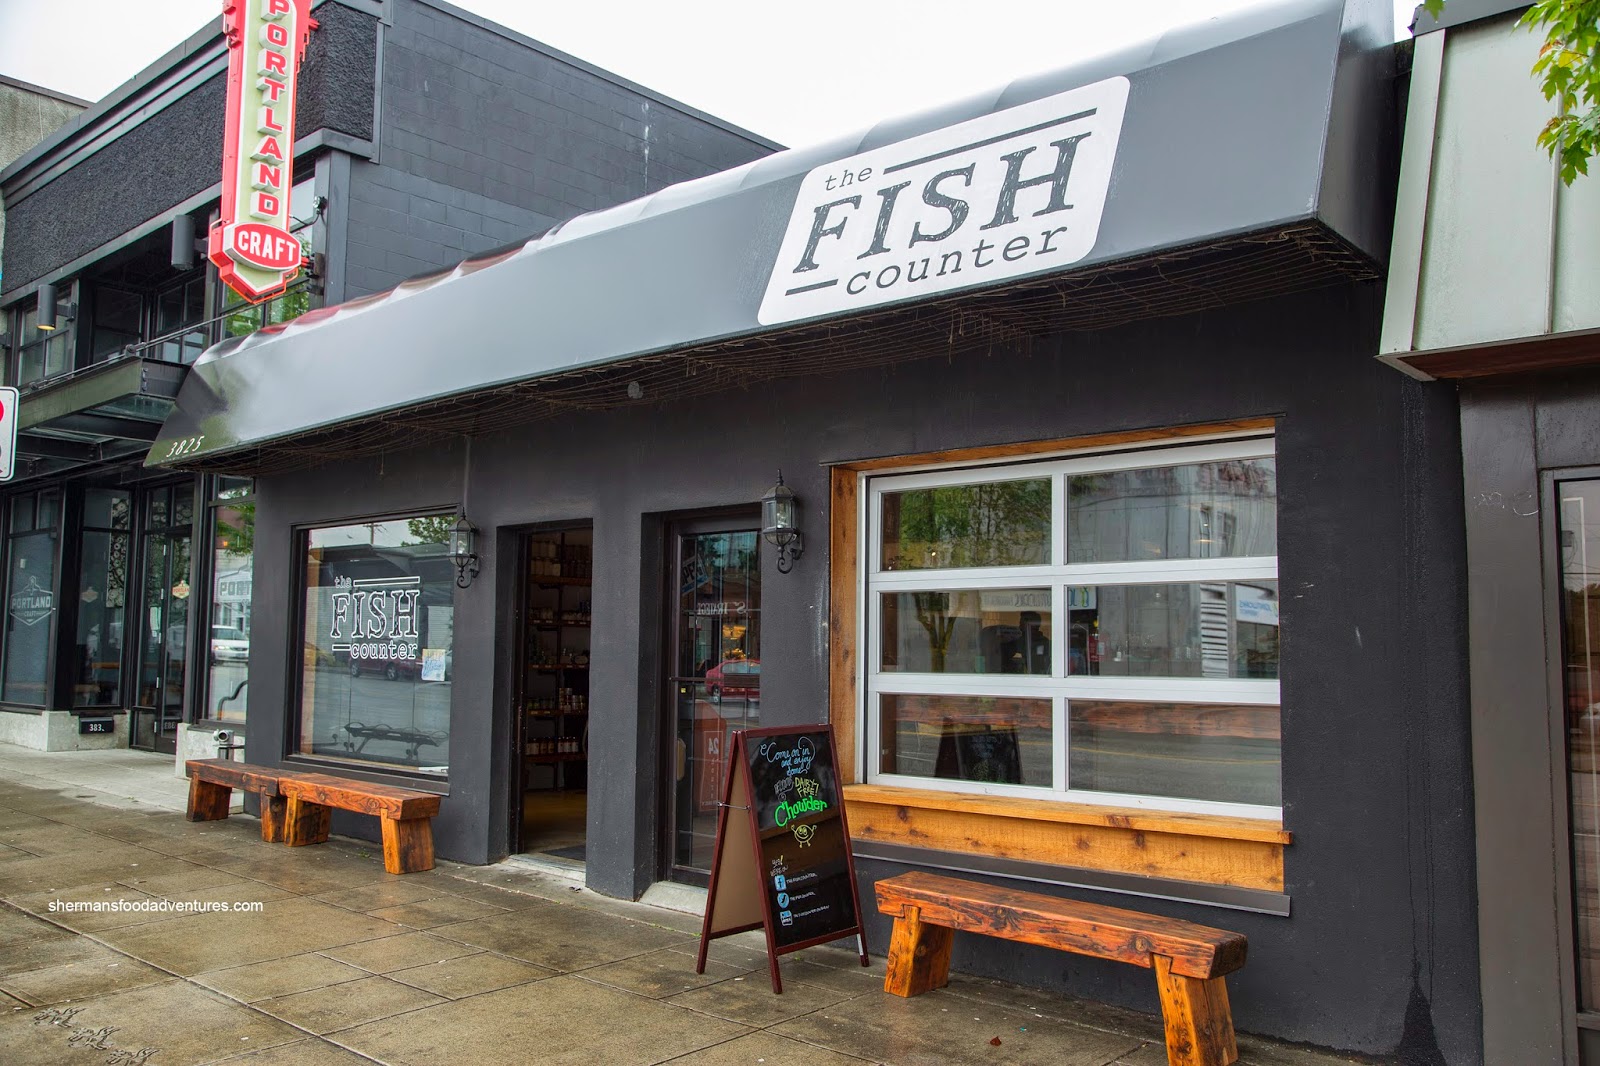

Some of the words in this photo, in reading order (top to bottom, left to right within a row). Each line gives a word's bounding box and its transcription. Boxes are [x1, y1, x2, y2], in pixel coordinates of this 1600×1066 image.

[258, 0, 291, 217] PORTLAND
[825, 166, 873, 192] the
[792, 131, 1093, 274] FISH
[237, 230, 297, 263] CRAFT
[846, 226, 1068, 296] counter
[166, 435, 205, 458] 3825
[334, 575, 352, 588] the
[11, 595, 51, 609] PORTLAND
[330, 589, 420, 638] FISH
[350, 640, 418, 660] counter
[761, 742, 790, 763] Come
[791, 747, 800, 758] on
[781, 758, 792, 768] and
[793, 755, 812, 769] enjoy
[774, 795, 828, 828] Chowder
